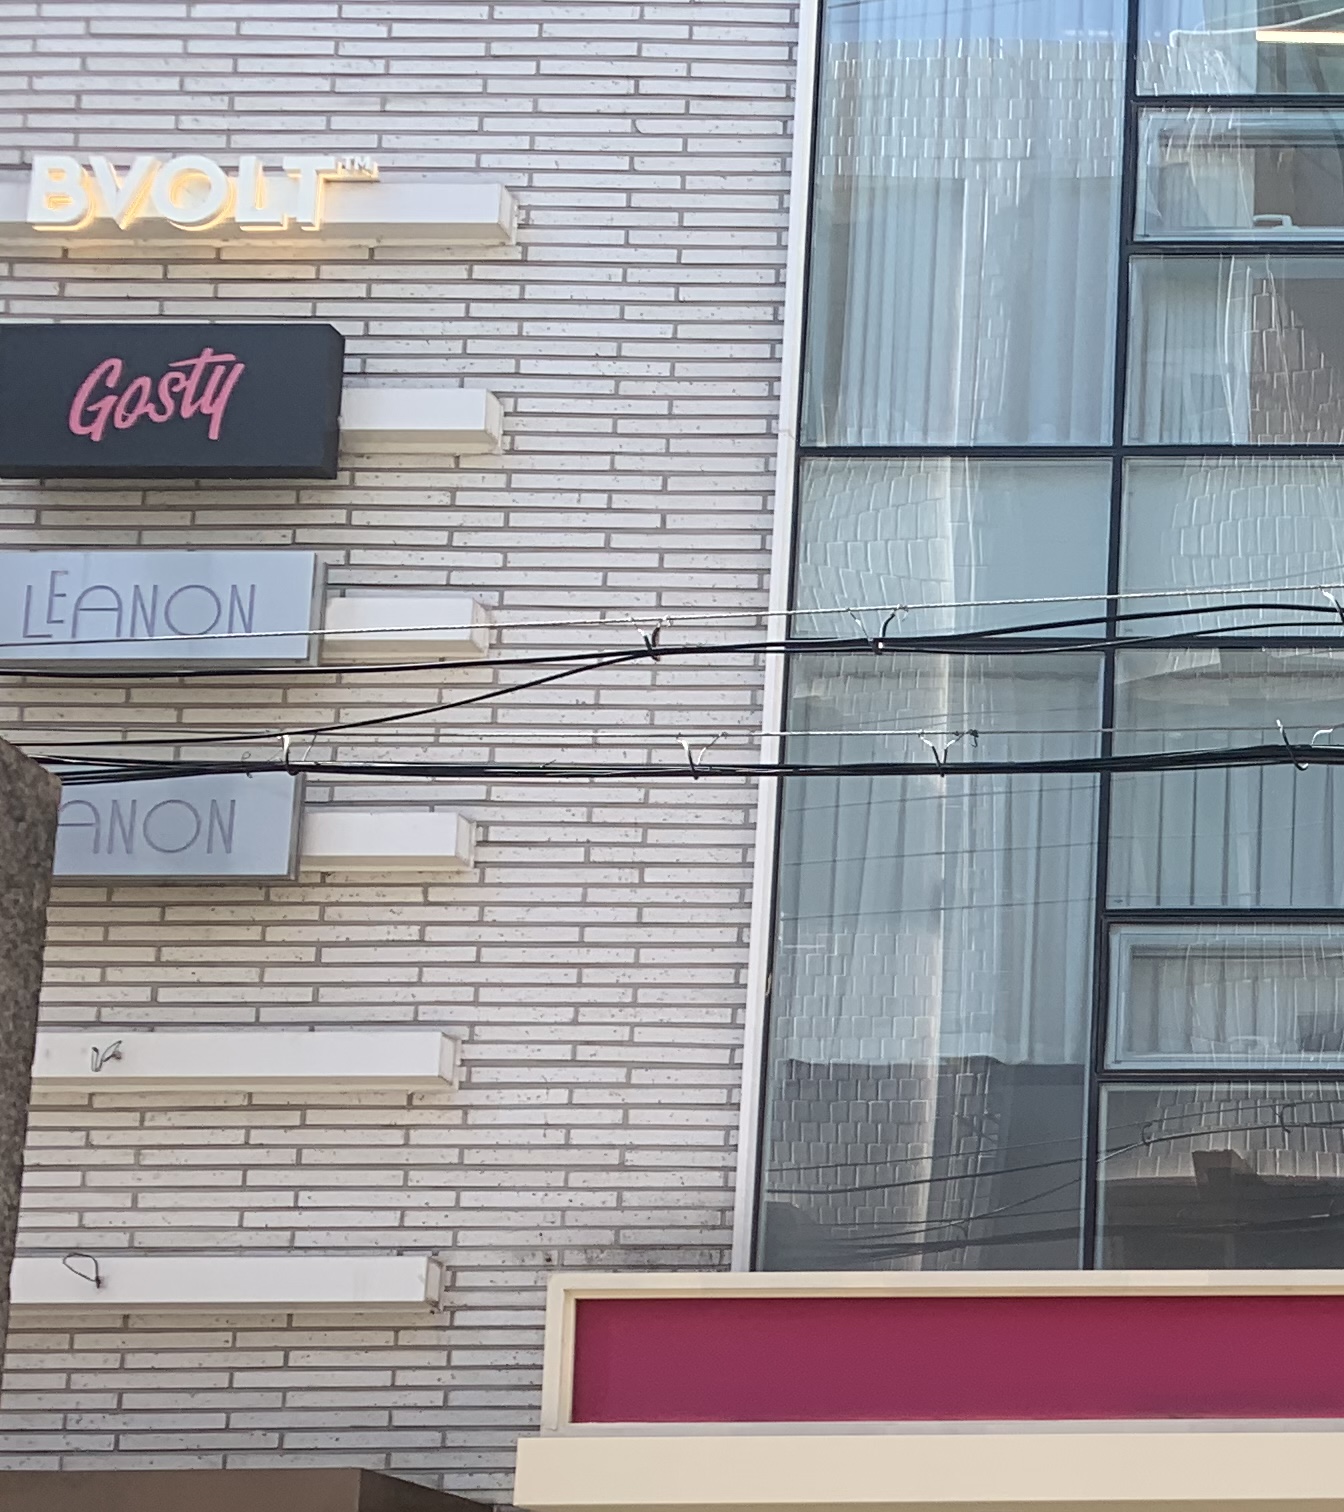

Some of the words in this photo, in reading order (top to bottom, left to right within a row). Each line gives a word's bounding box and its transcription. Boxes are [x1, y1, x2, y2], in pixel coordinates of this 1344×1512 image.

[68, 347, 245, 442] Gosty
[22, 570, 257, 639] LEANON
[57, 799, 236, 854] ANON
